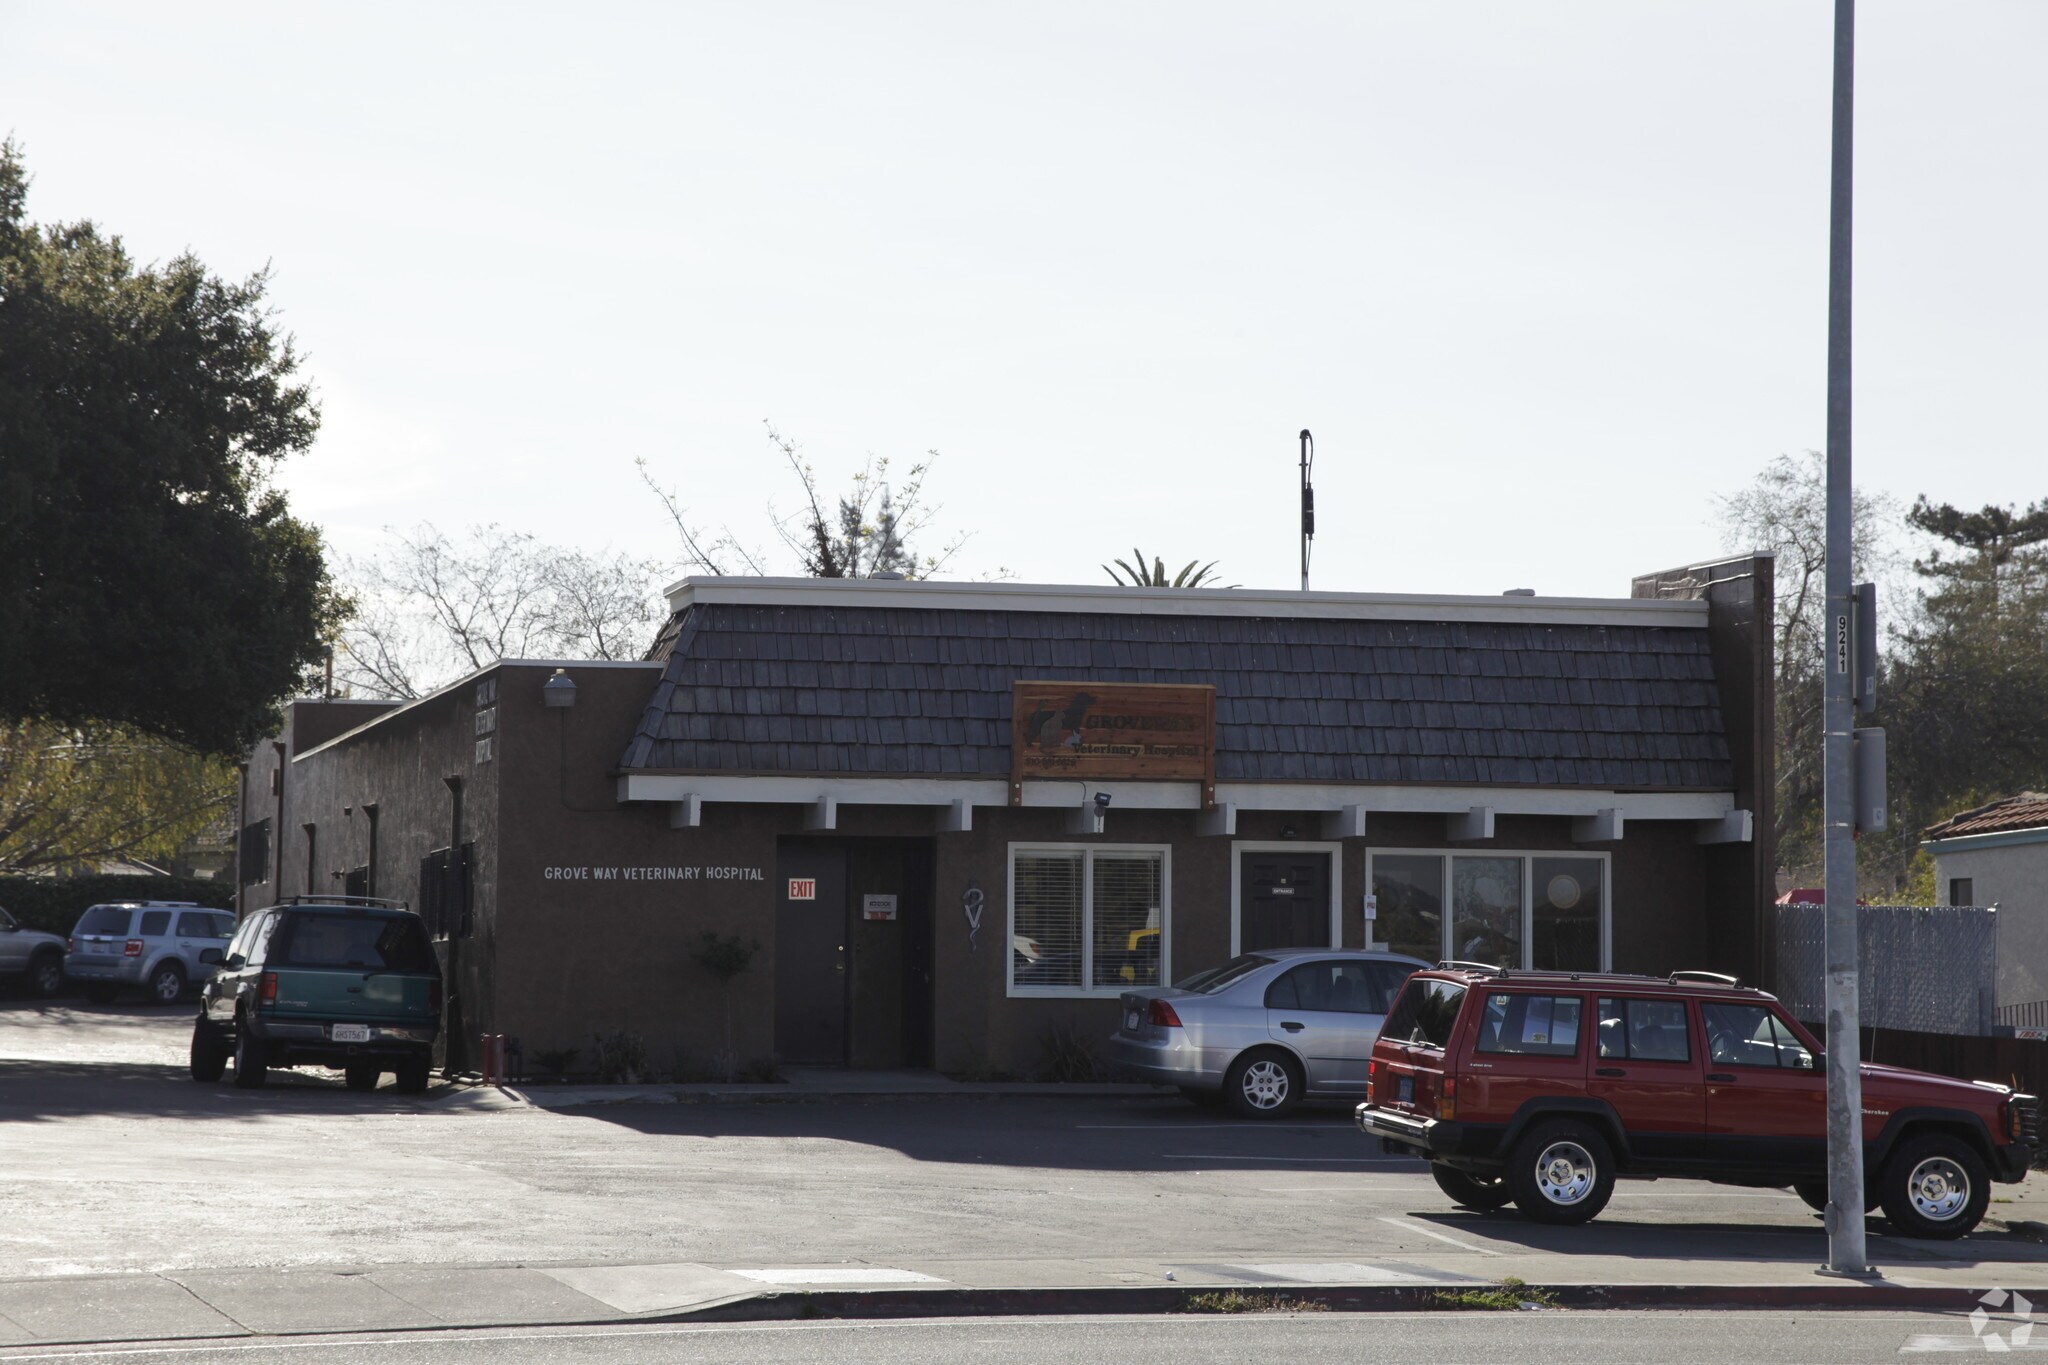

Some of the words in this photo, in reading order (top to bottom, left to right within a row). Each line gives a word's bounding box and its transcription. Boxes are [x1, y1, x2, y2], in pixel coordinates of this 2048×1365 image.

[1838, 616, 1846, 673] 9241
[1073, 743, 1141, 758] Veterinary
[544, 866, 588, 880] GROVE
[593, 866, 619, 880] WAY
[623, 866, 701, 881] VETERINARY
[705, 866, 765, 881] HOSPITAL
[790, 881, 815, 898] EXIT
